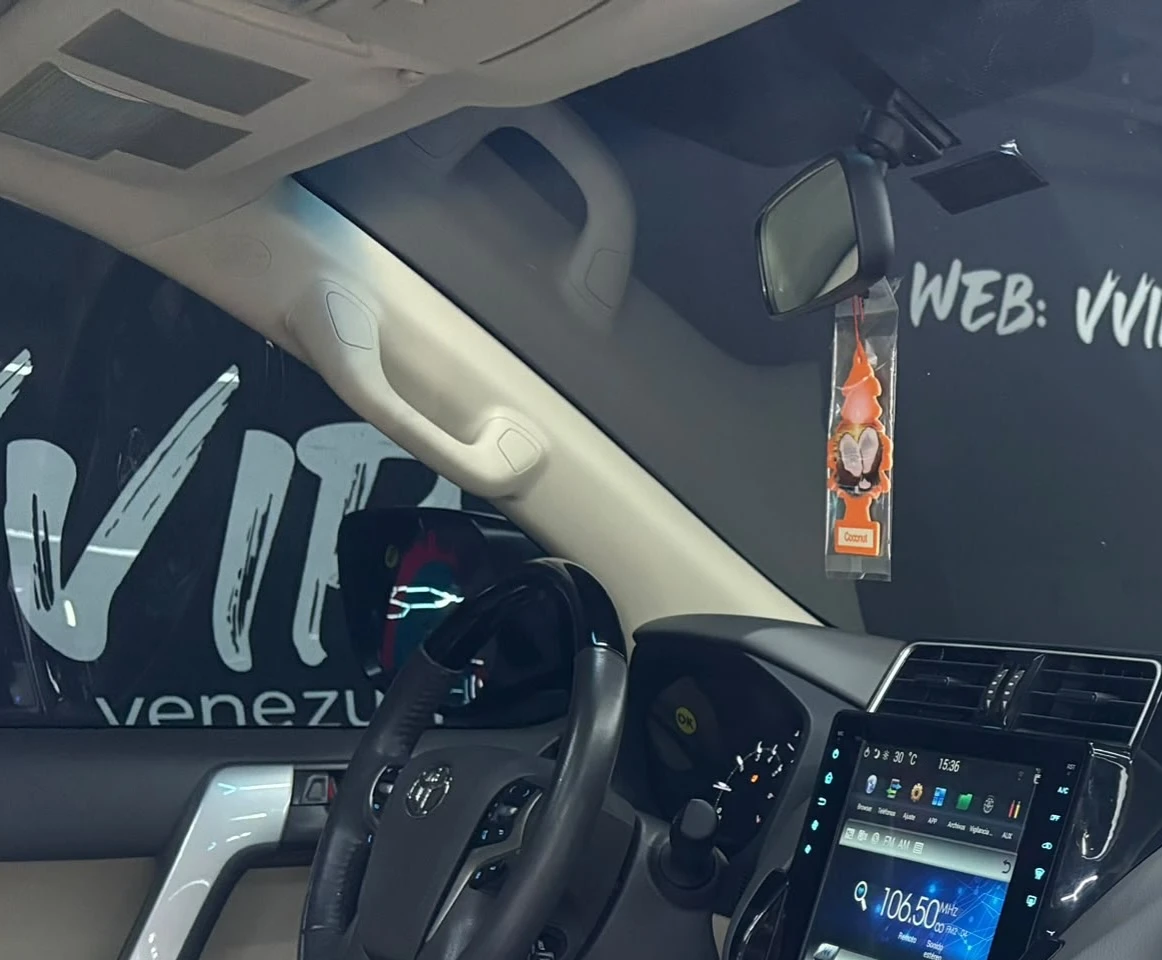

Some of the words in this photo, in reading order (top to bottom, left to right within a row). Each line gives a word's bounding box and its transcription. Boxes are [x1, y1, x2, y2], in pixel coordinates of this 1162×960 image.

[909, 258, 1047, 336] WEB:
[0, 349, 462, 672] VIP
[844, 531, 869, 543] Coconut
[96, 691, 386, 726] venezu
[893, 751, 904, 763] 30
[938, 758, 960, 773] 15:36
[880, 887, 940, 929] 106.50
[940, 901, 959, 917] MHz
